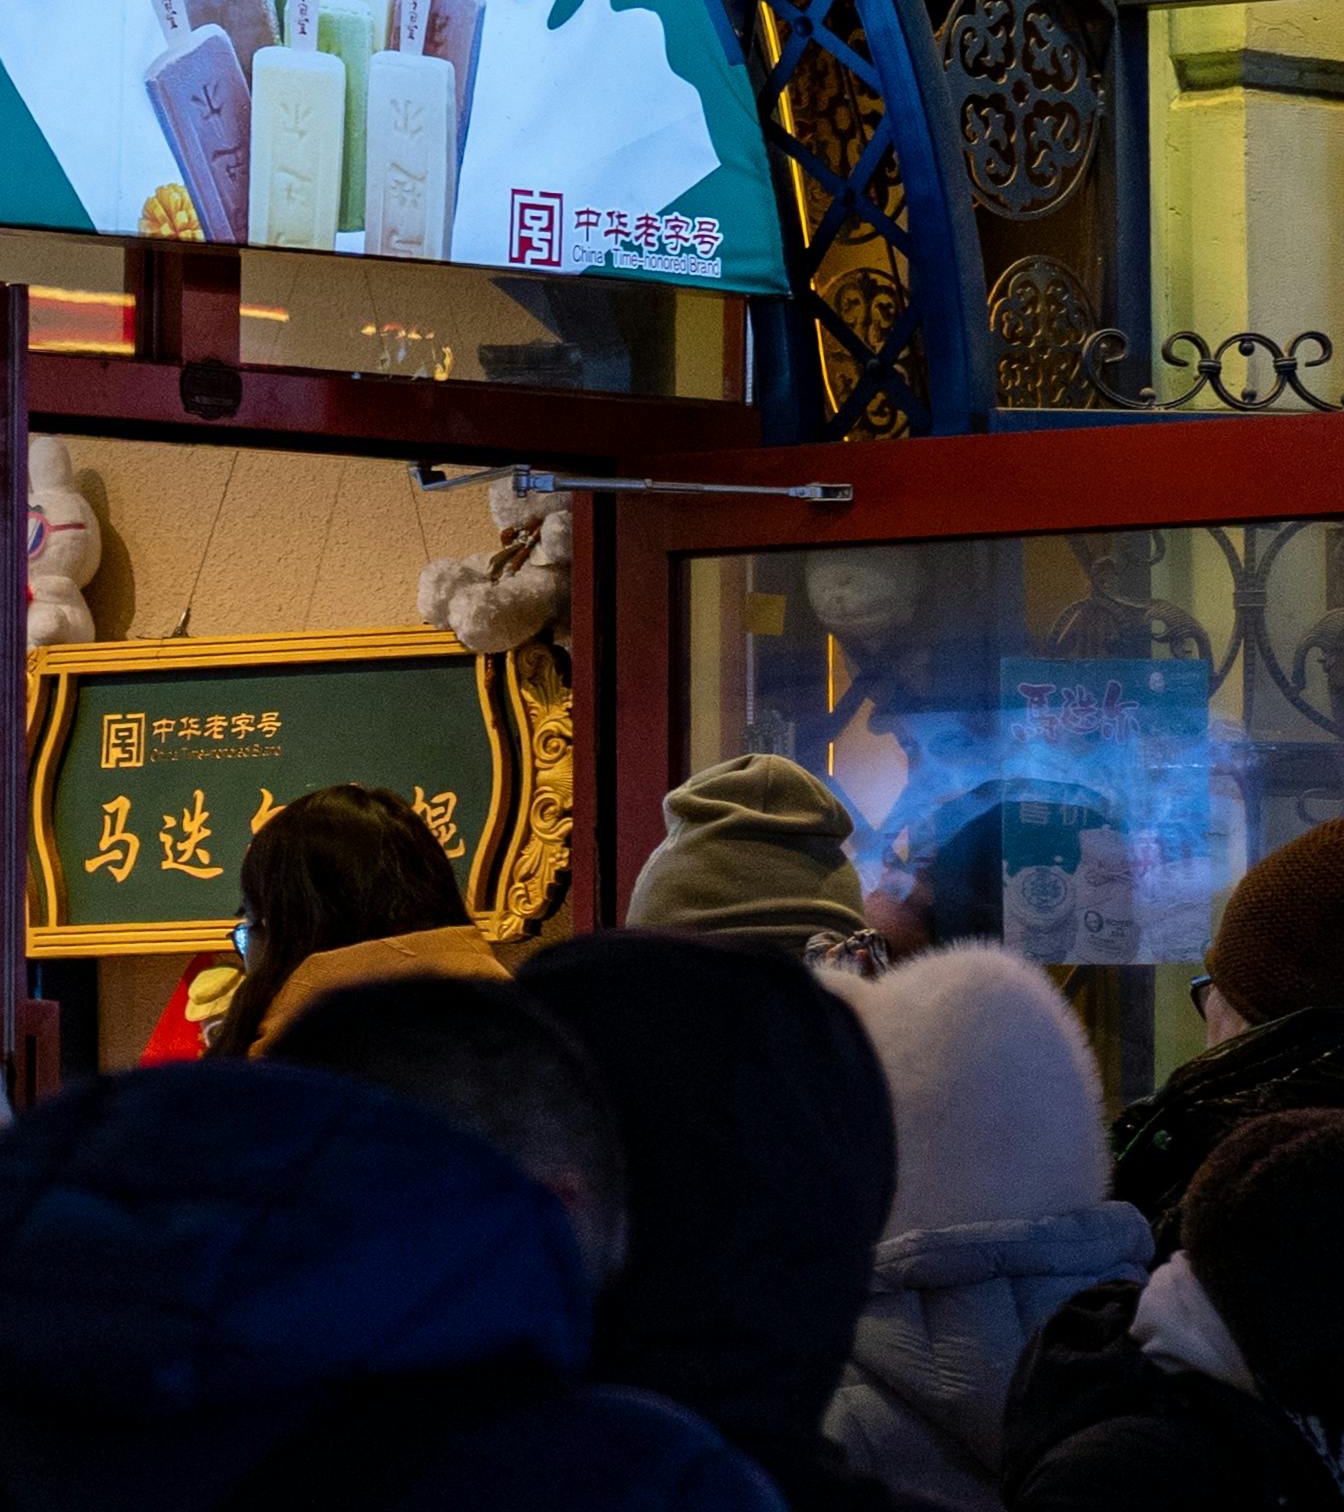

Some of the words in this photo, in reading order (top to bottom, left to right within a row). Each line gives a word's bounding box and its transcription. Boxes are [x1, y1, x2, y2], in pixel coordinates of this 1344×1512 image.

[573, 207, 721, 257] 中华老字号
[572, 244, 604, 265] China
[611, 248, 686, 273] Time-honored
[688, 255, 721, 277] Brand
[151, 711, 283, 744] 中华老字号
